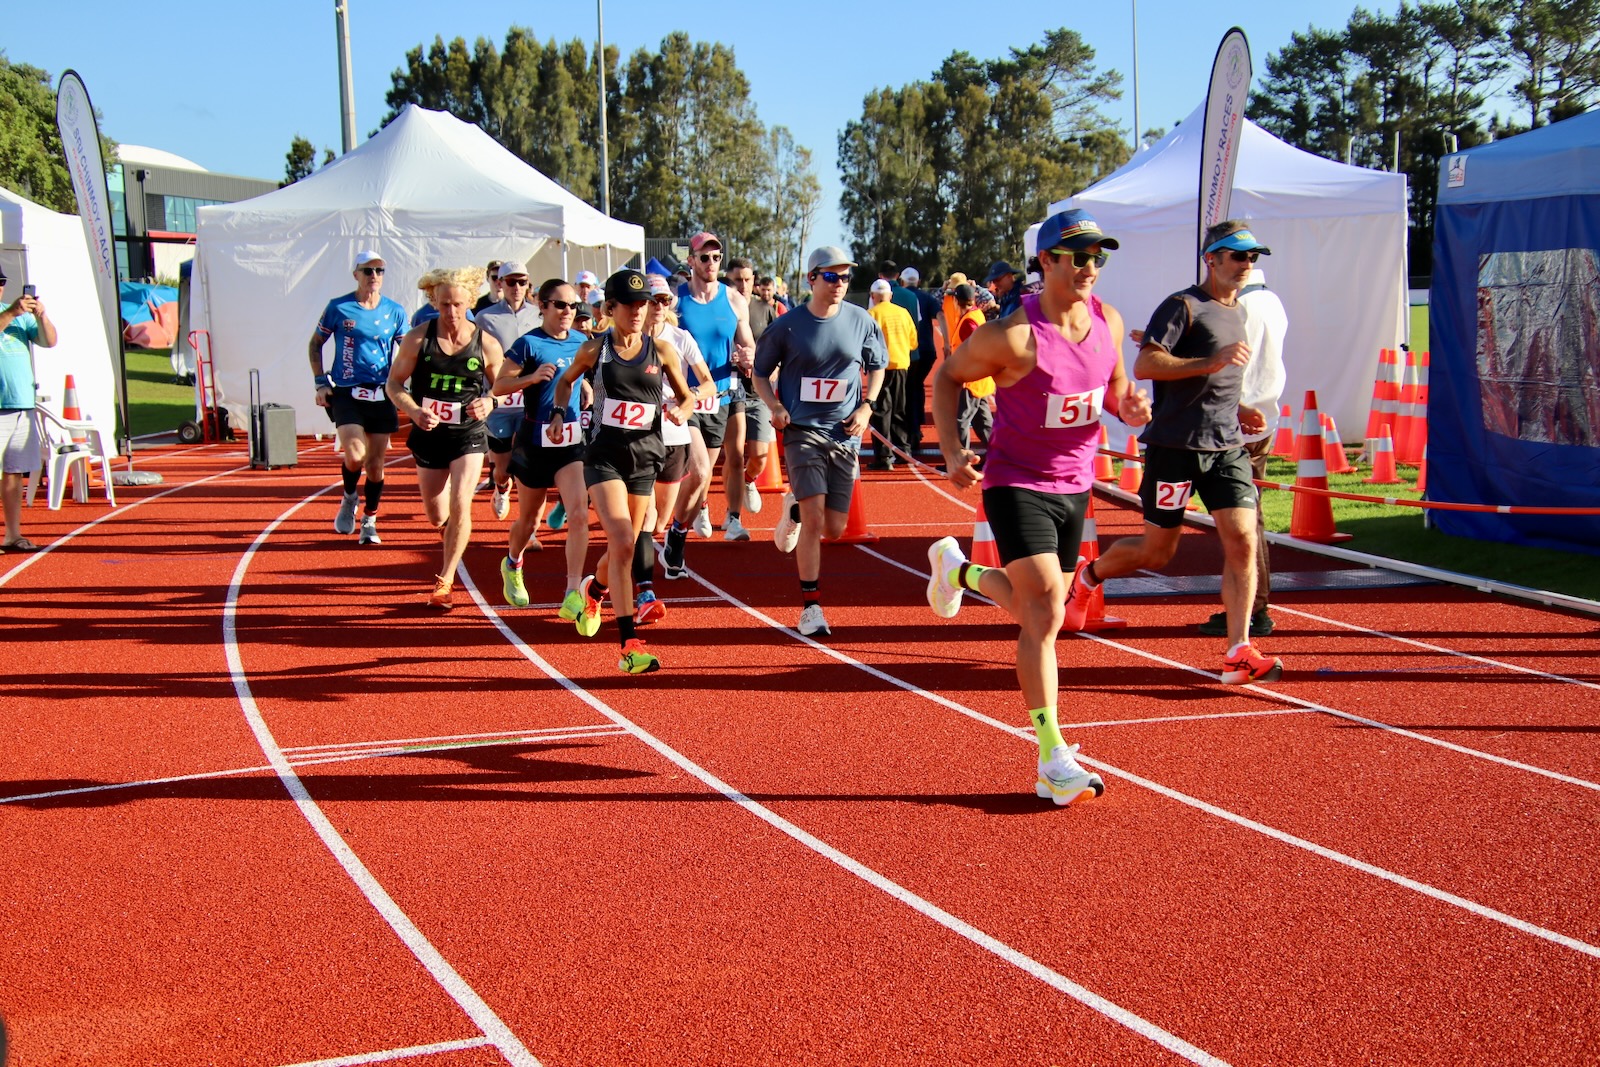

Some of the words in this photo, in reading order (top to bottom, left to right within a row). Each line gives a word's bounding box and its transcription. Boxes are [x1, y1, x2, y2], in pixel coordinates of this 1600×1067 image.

[1205, 152, 1223, 227] CHINMOY
[1218, 93, 1233, 150] RACES
[73, 127, 83, 154] SRI
[80, 155, 100, 222] CHINMOY
[430, 373, 467, 393] TTT
[811, 379, 839, 400] 17
[504, 389, 523, 406] 37
[1059, 392, 1093, 424] 51
[429, 400, 453, 421] 45
[611, 402, 646, 427] 42
[1158, 482, 1192, 507] 27
